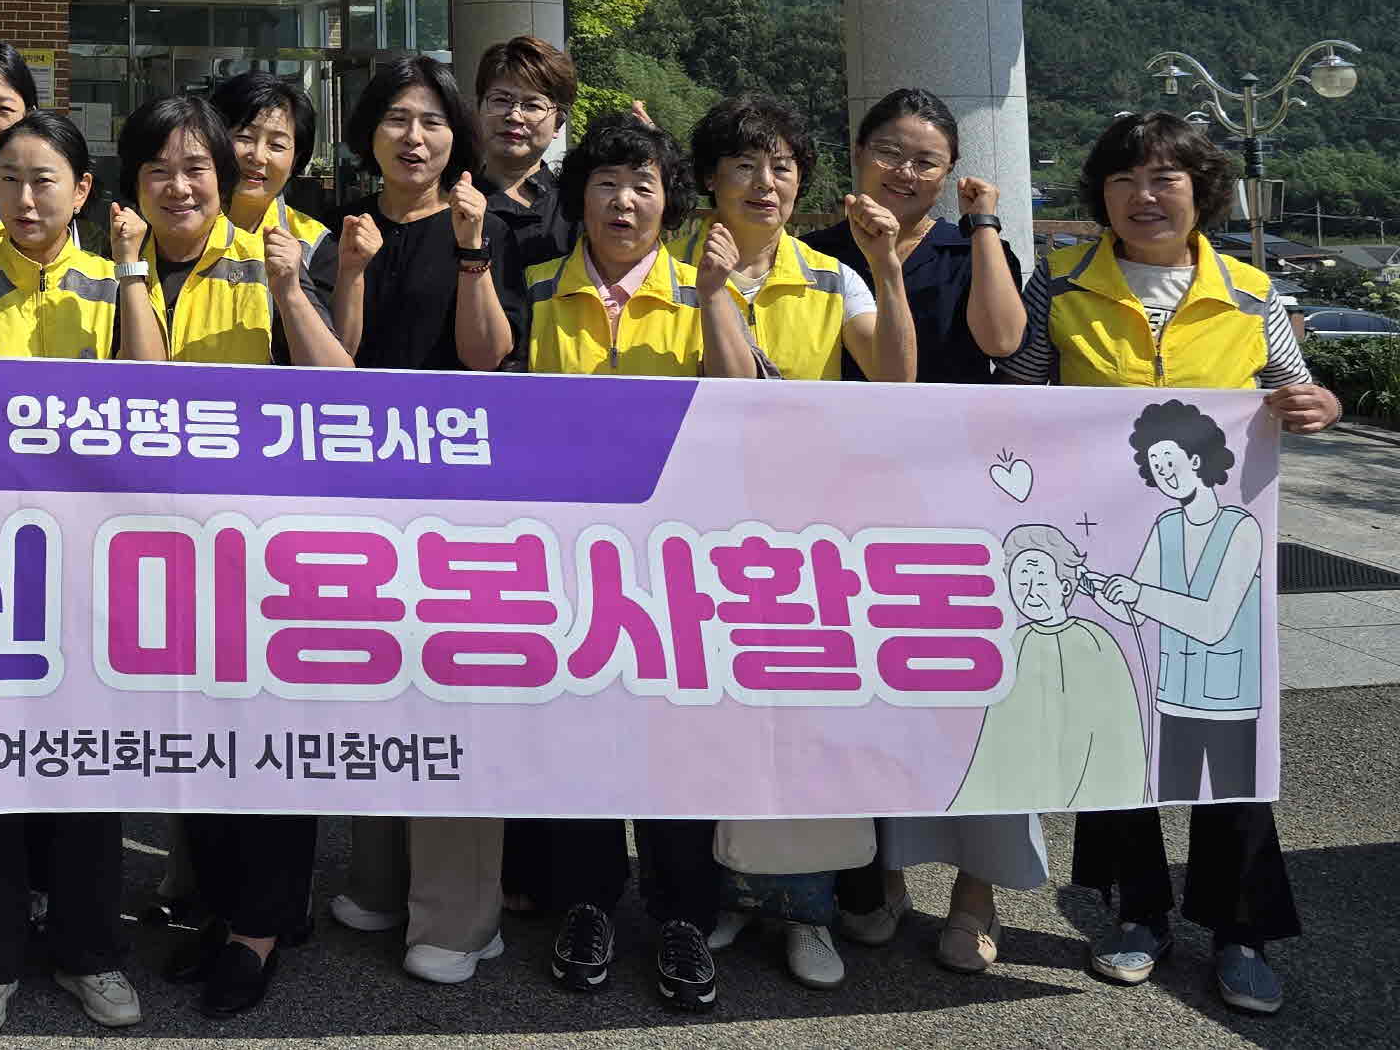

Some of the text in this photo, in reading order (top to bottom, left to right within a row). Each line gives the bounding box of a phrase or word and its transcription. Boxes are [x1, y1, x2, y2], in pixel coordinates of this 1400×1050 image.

[6, 395, 241, 460] 양성평등
[260, 402, 492, 467] 기금사업
[107, 527, 1004, 692] 미용봉사활동
[254, 731, 464, 783] 시민참여단
